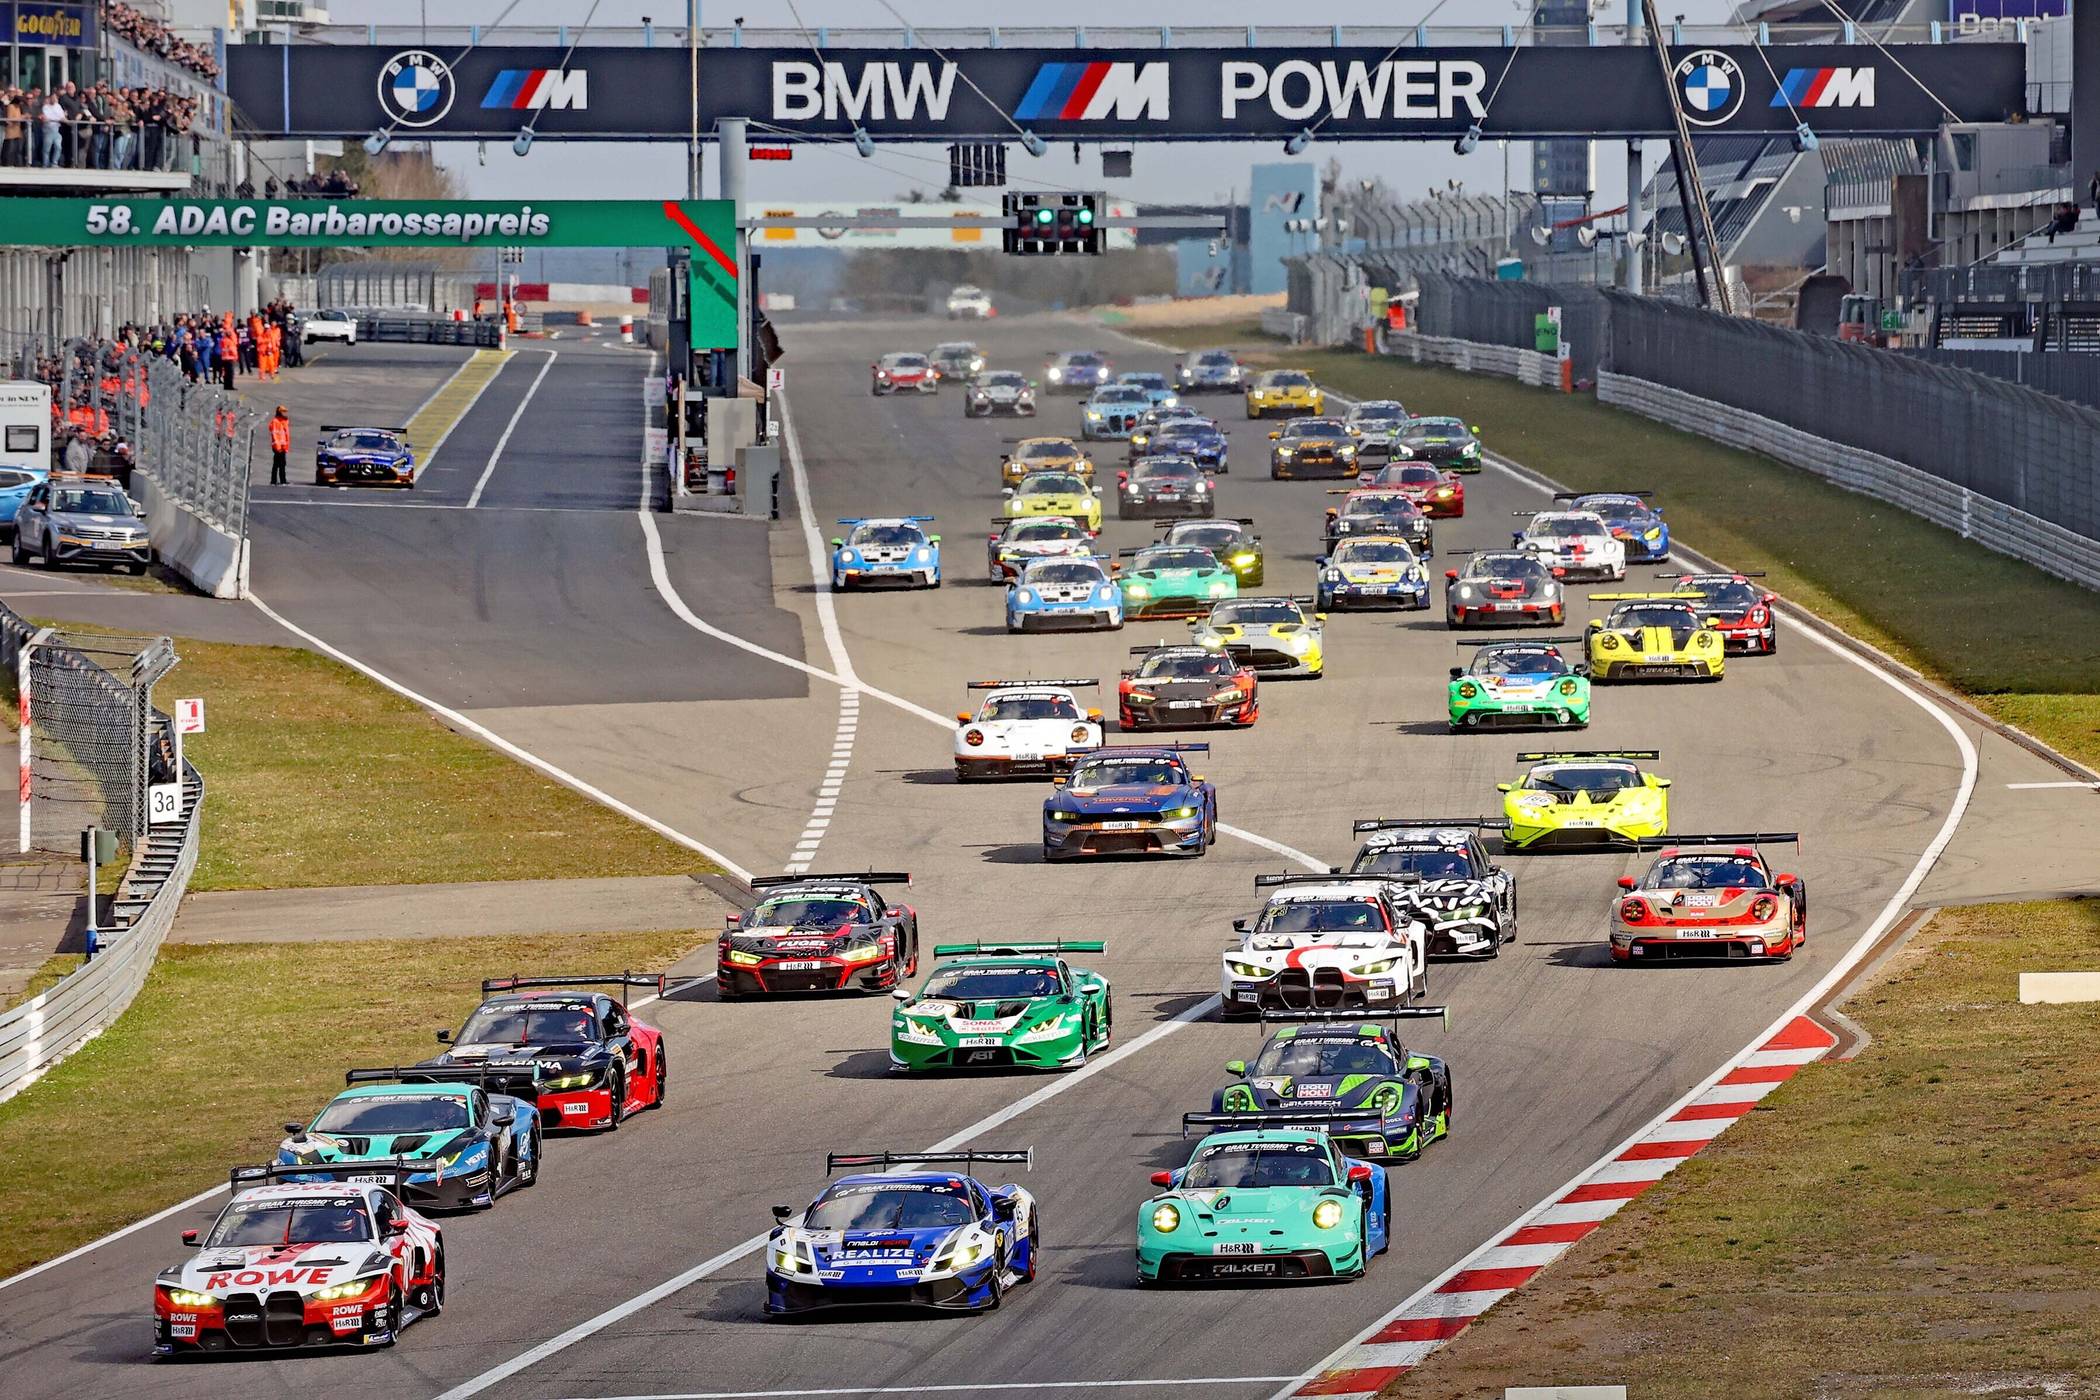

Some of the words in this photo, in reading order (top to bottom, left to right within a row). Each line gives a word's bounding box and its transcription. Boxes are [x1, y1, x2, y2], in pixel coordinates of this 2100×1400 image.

[388, 54, 445, 77] BMW
[1681, 54, 1736, 76] BMW
[772, 61, 958, 121] BMW
[1221, 60, 1488, 121] POWER
[86, 205, 140, 235] 58.
[152, 205, 256, 236] ADAC
[265, 205, 549, 242] Barbarossapreis
[154, 791, 175, 813] 3a
[769, 886, 860, 895] FALKEN
[967, 1050, 995, 1063] ABT
[1225, 1144, 1249, 1152] GRAN
[465, 1150, 488, 1166] MEYLE
[256, 1184, 345, 1194] ROWE
[858, 1185, 886, 1193] GRAN
[886, 1184, 925, 1192] TURISMO
[258, 1200, 285, 1209] GRAN
[285, 1199, 329, 1207] TURISMO
[832, 1248, 915, 1260] REALIZE
[1220, 1243, 1241, 1254] H&R
[1212, 1263, 1276, 1273] FALKEN
[206, 1268, 333, 1290] ROWE
[333, 1304, 363, 1316] ROWE
[170, 1313, 197, 1322] ROWE
